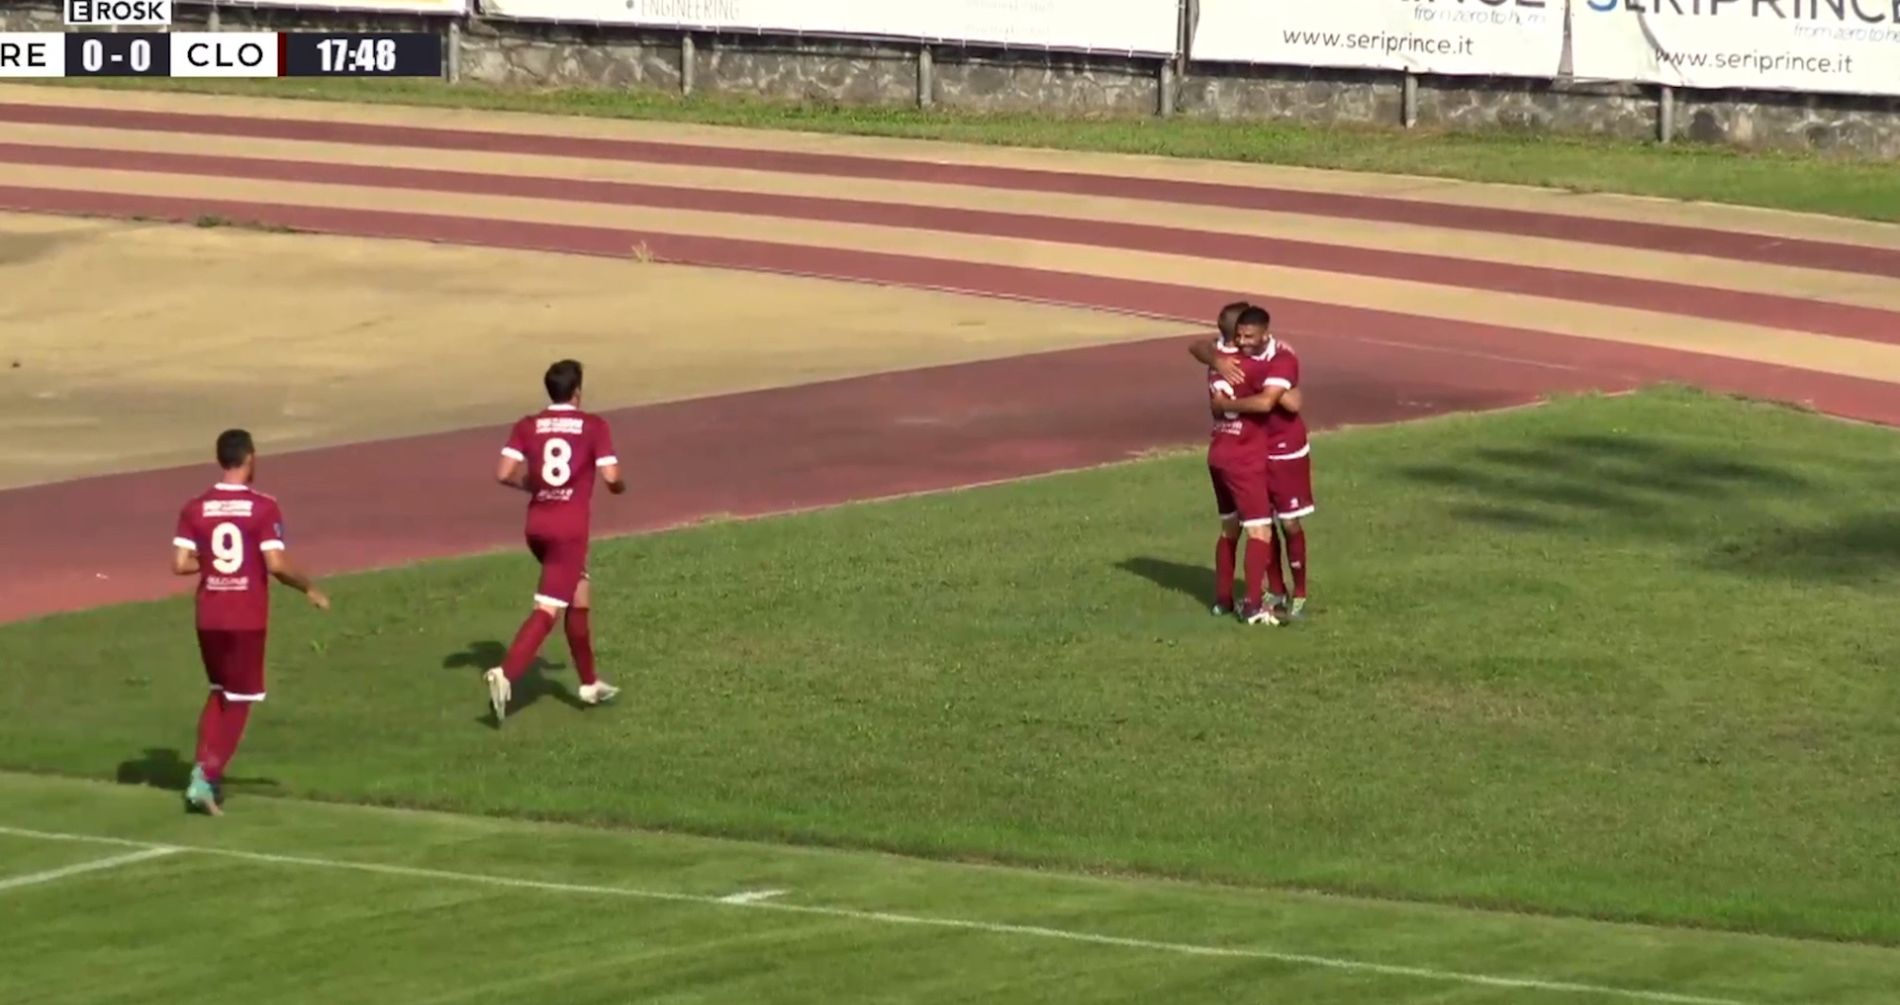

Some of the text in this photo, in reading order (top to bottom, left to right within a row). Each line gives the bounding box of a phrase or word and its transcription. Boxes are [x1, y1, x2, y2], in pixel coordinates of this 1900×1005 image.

[1283, 28, 1474, 56] www.seriprince.it
[1655, 47, 1853, 74] www.seriprince.it
[542, 437, 572, 487] 8
[211, 521, 244, 574] 9
